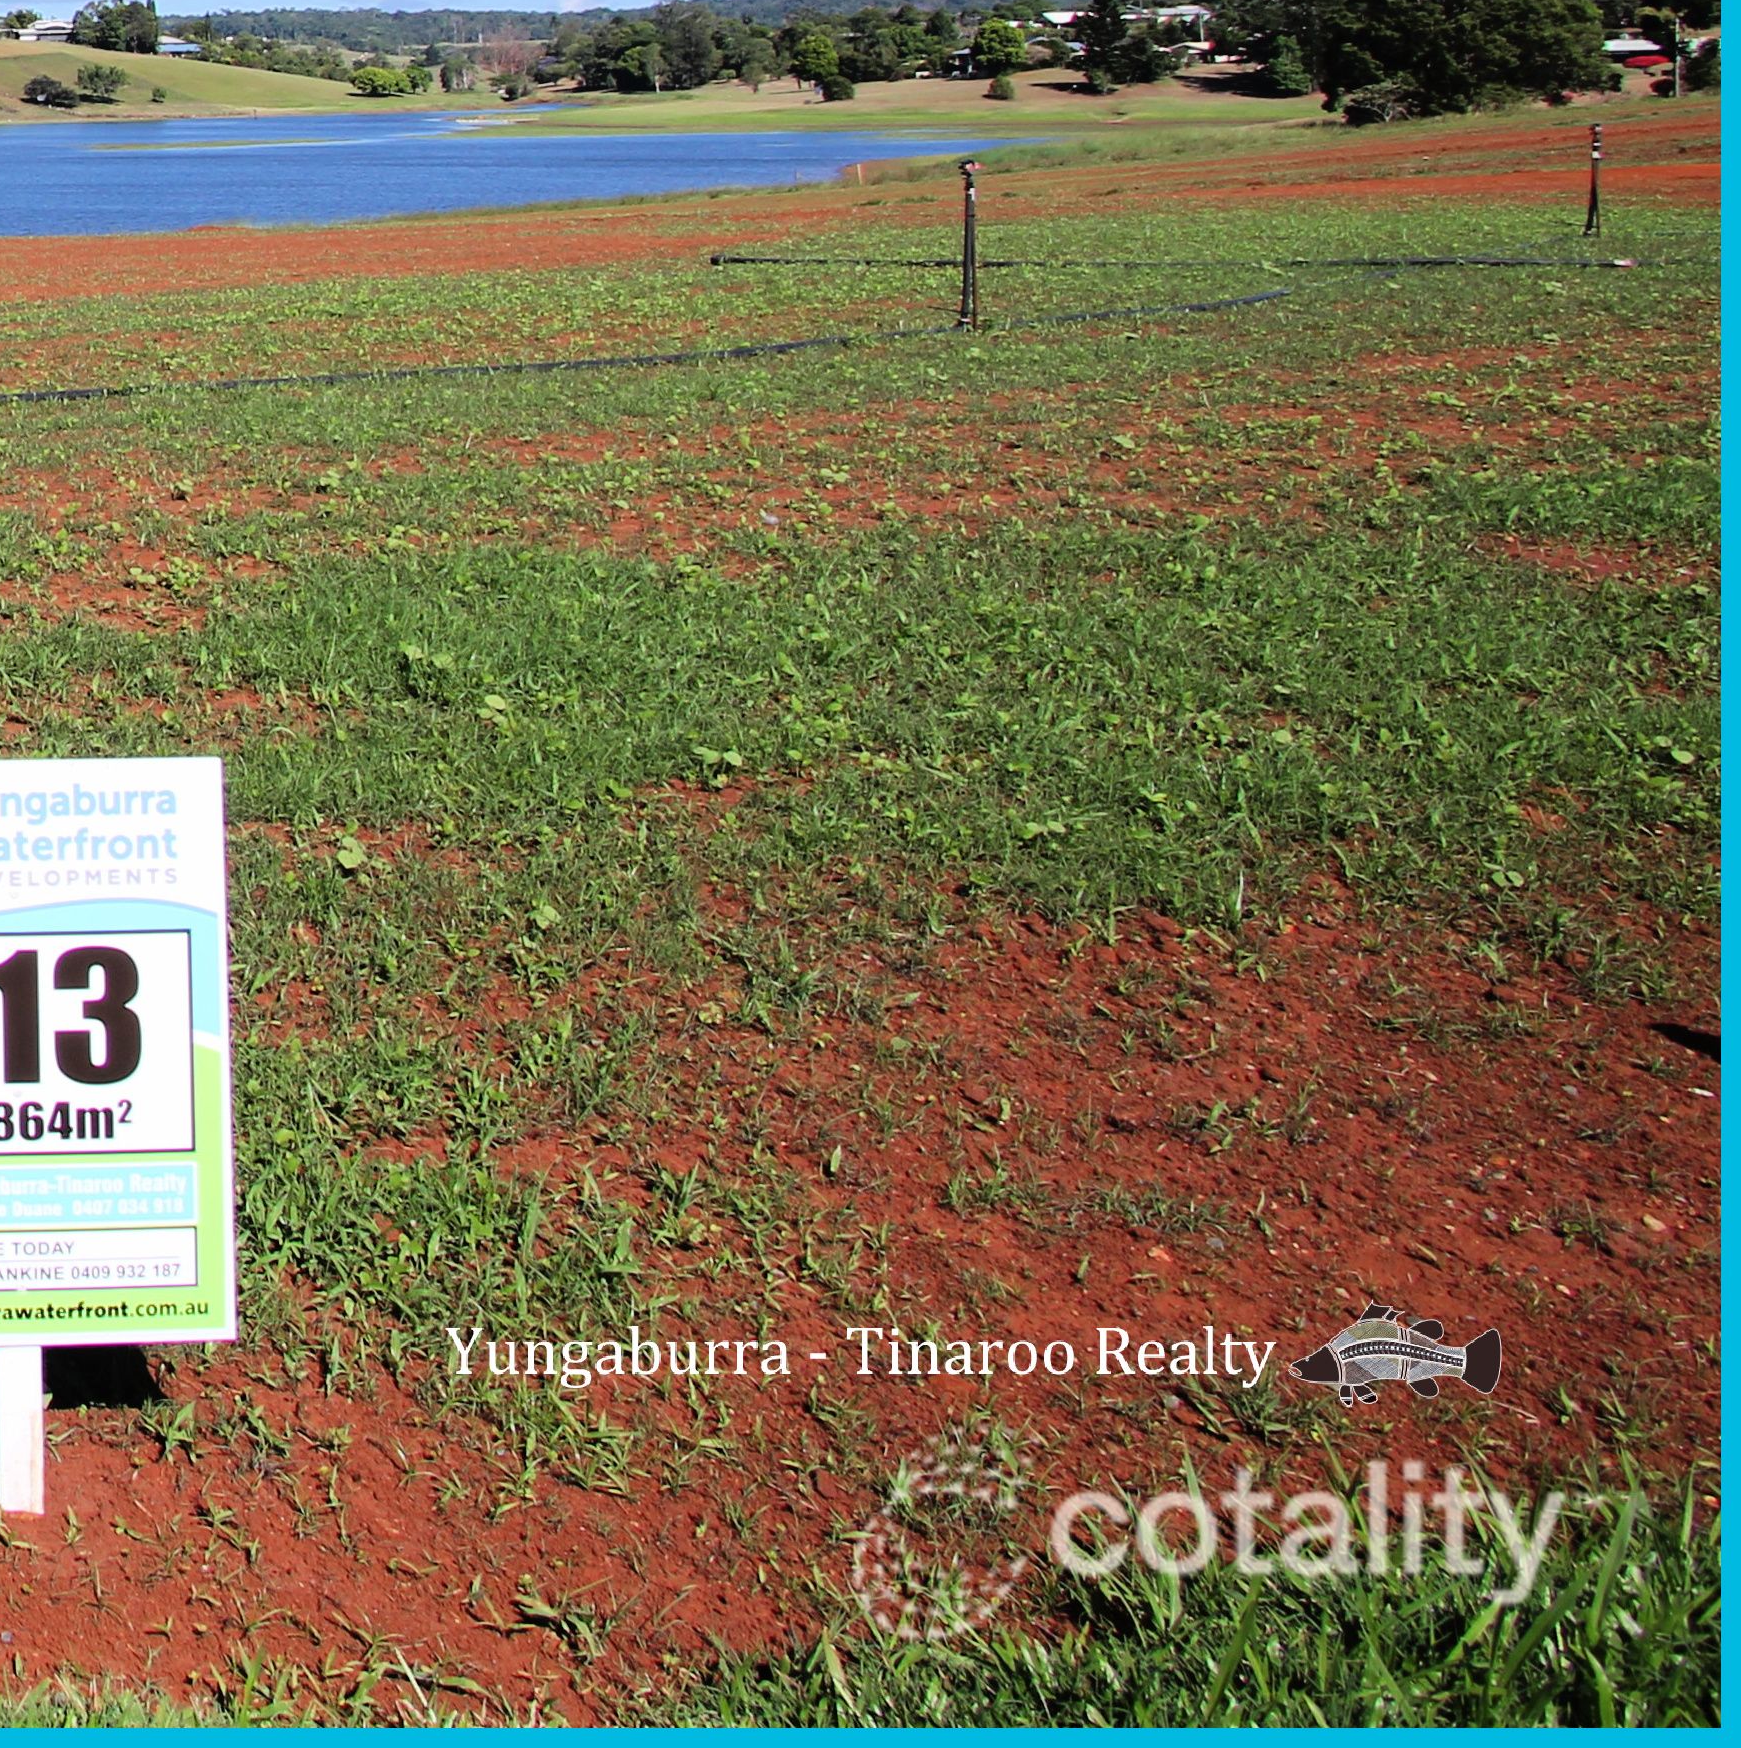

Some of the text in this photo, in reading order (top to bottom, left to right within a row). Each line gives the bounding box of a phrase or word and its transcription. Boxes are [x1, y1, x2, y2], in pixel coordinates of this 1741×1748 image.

[129, 1172, 187, 1196] Realty
[11, 1240, 76, 1256] TODAY
[71, 1264, 111, 1280] 0409
[116, 1264, 147, 1280] 932
[153, 1262, 181, 1278] 187
